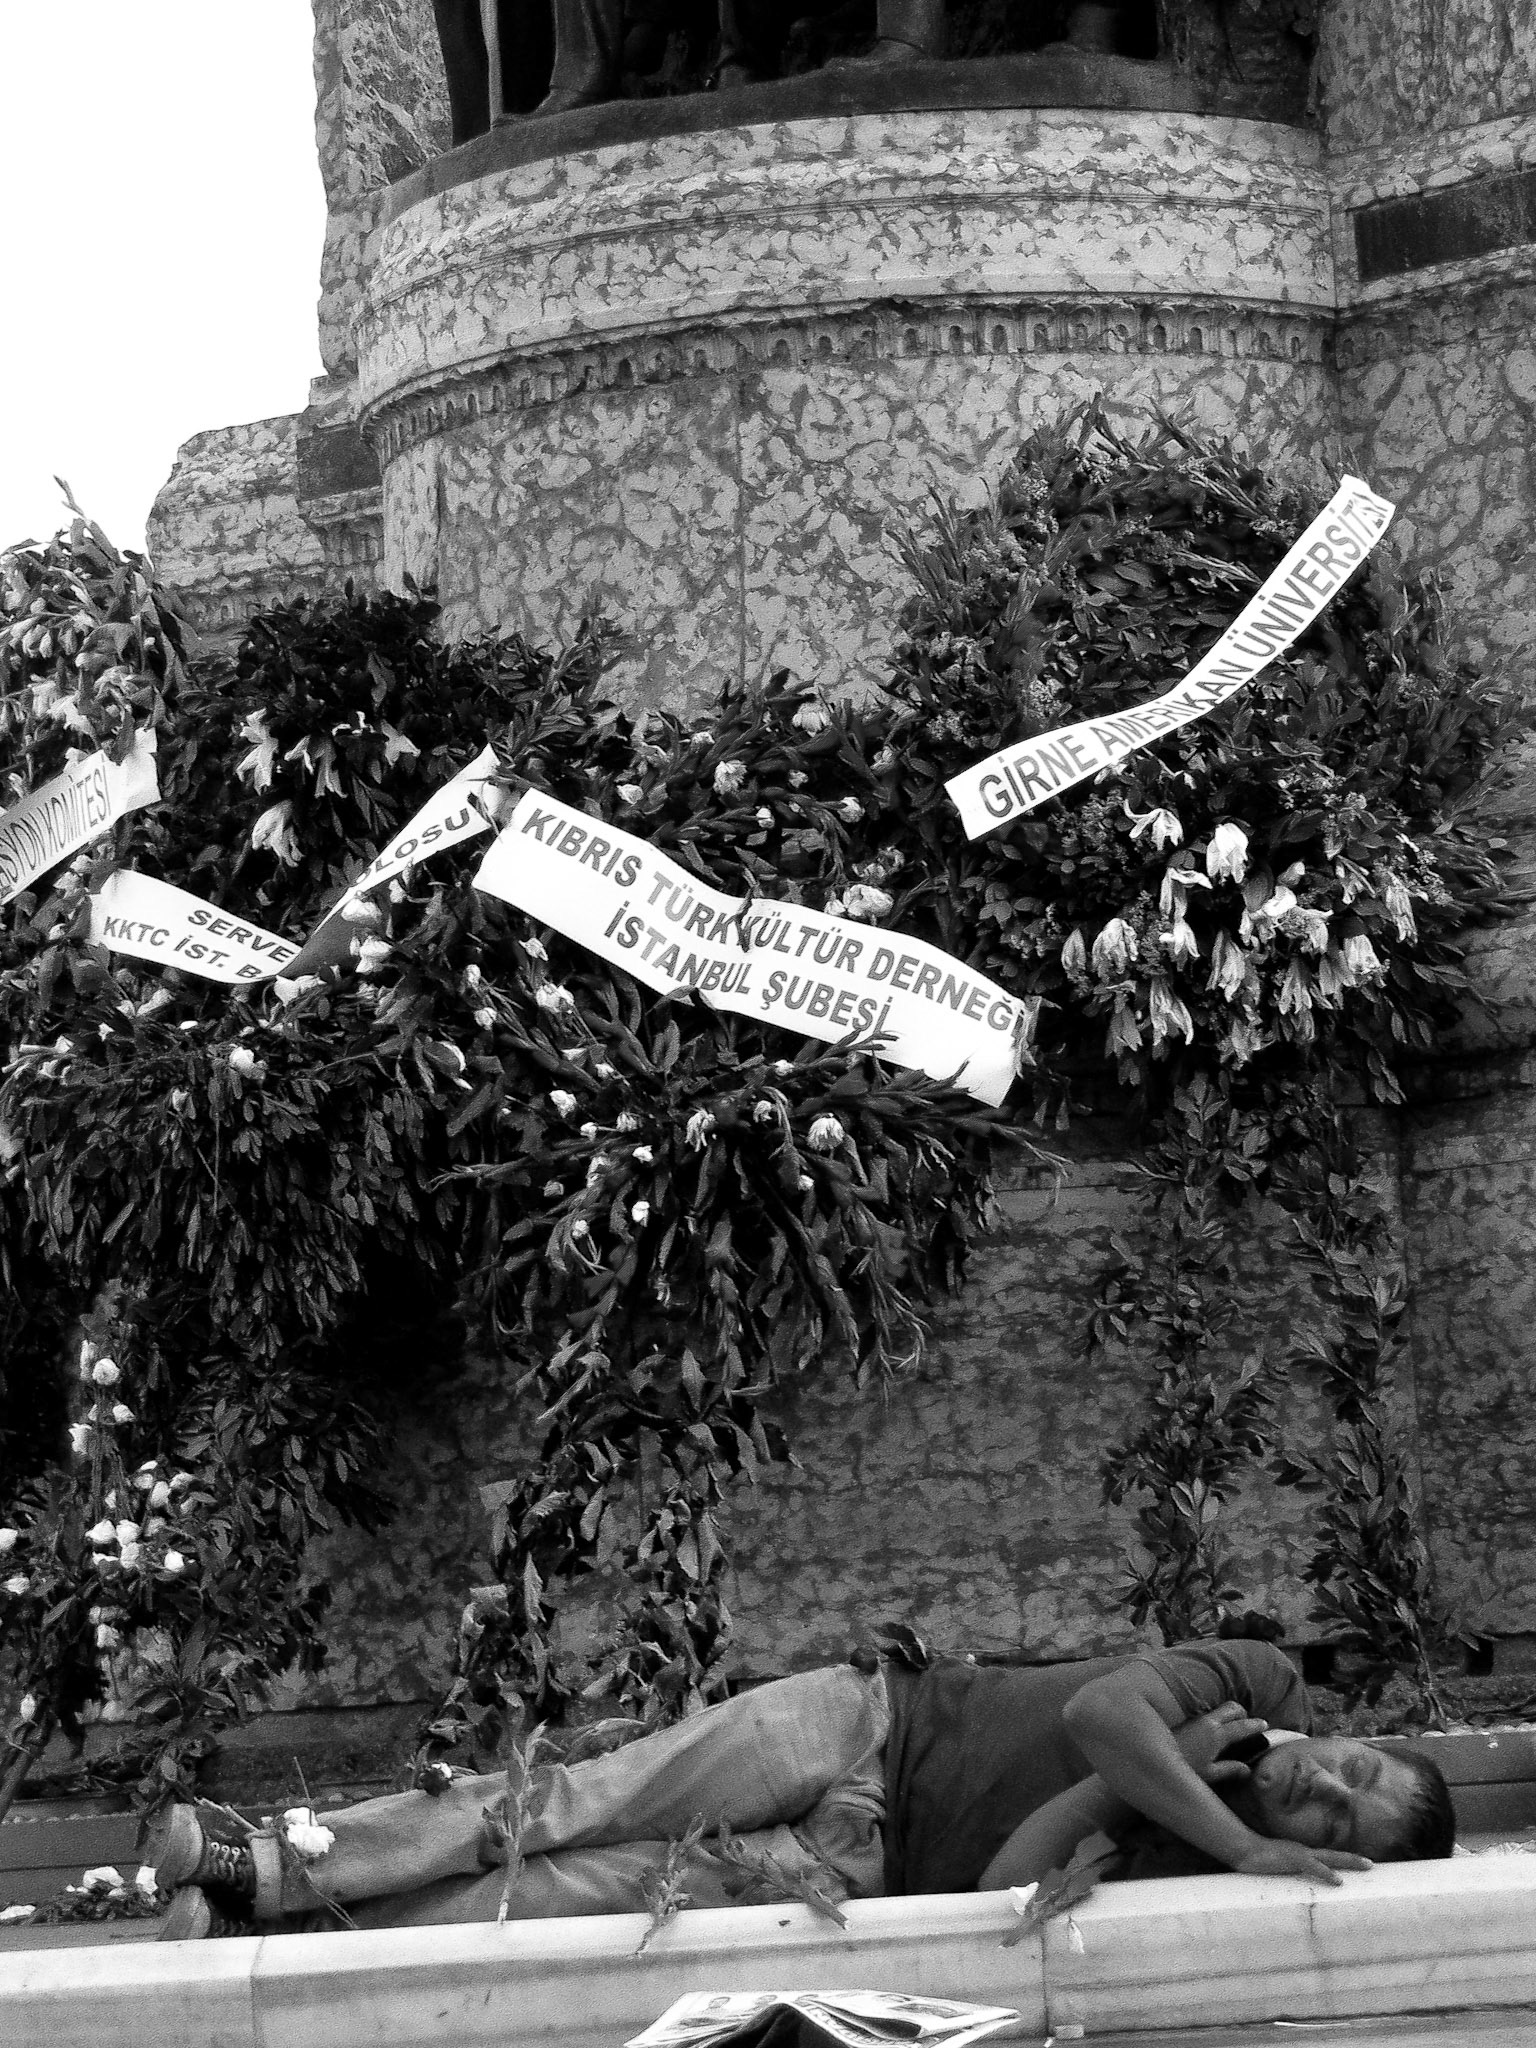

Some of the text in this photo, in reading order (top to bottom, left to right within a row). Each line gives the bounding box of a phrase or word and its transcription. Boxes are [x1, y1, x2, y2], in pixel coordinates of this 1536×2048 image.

[978, 734, 1099, 818] GİRNE
[1089, 659, 1254, 756] AMERİKAN
[103, 916, 170, 947] KKTC
[173, 935, 230, 968] İST.
[187, 909, 295, 963] SERVE
[520, 808, 643, 887] KIBRIS
[647, 871, 735, 944] TÜRK
[604, 900, 893, 1034] İSTANBUL ŞUBESİ
